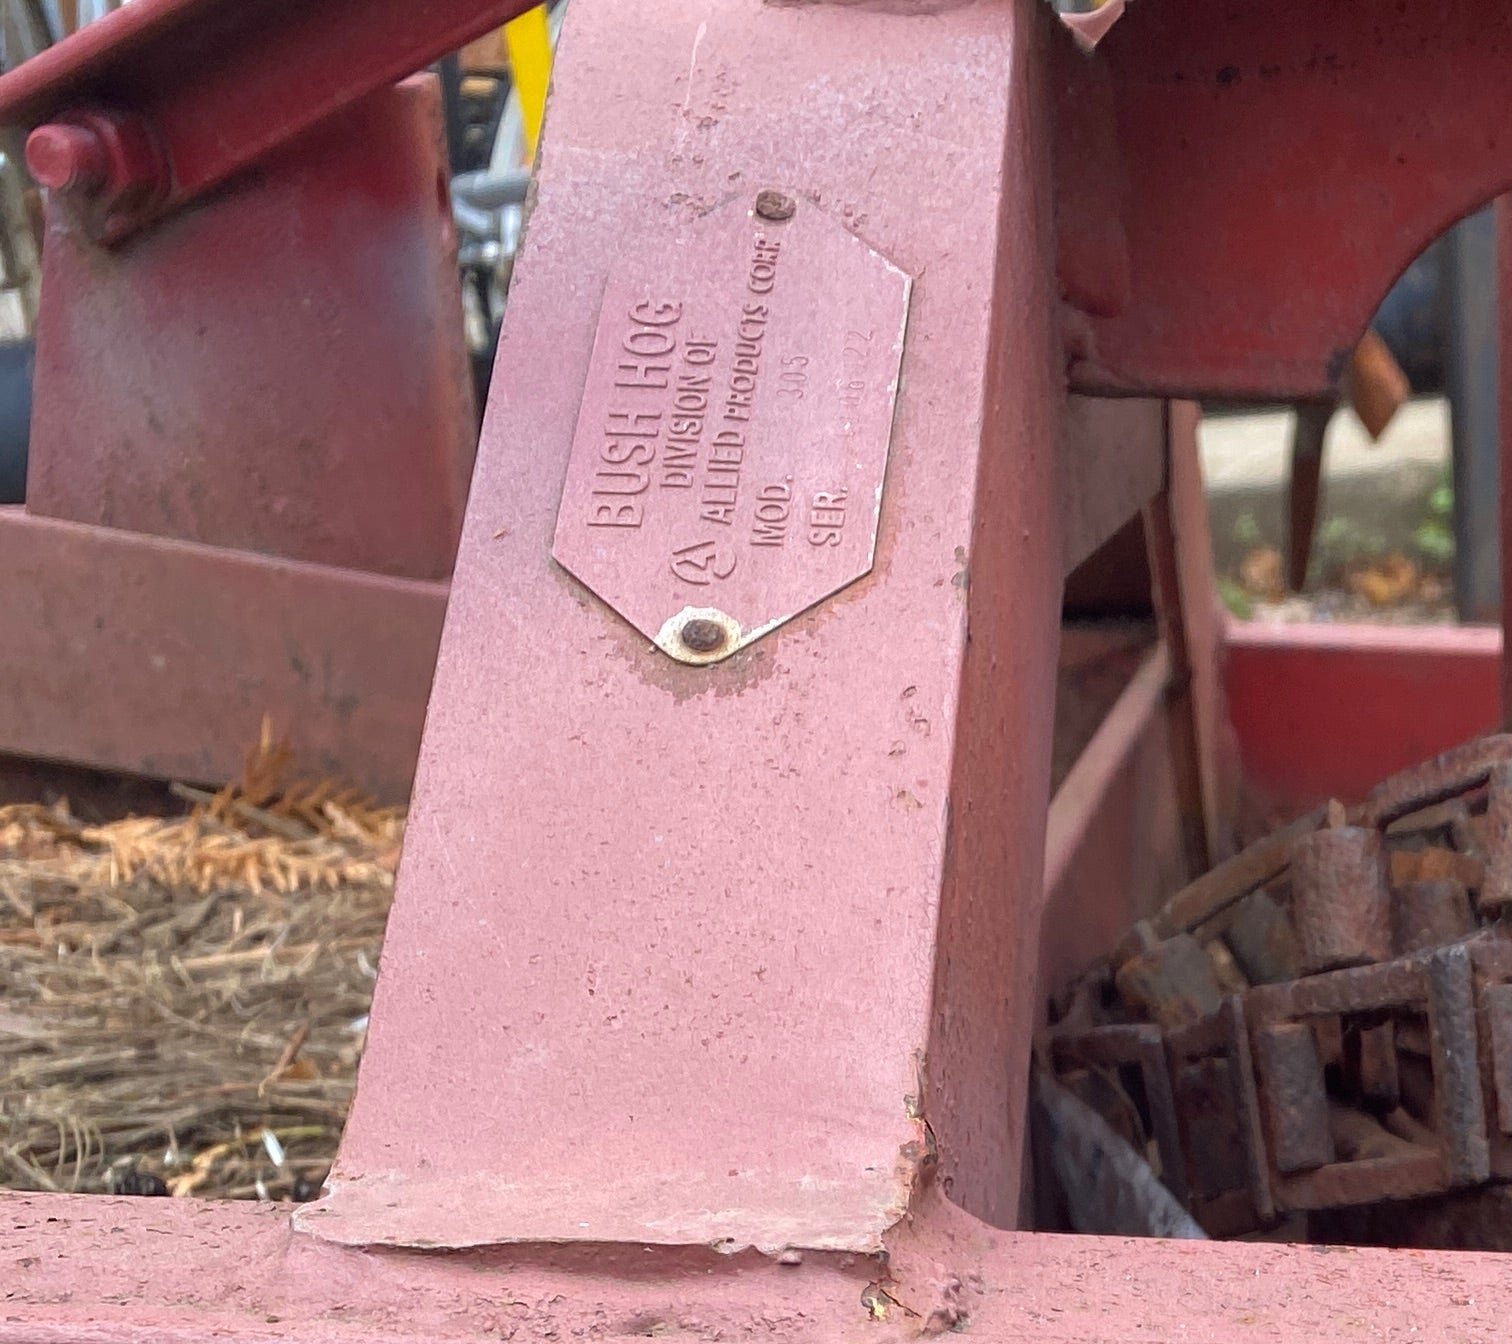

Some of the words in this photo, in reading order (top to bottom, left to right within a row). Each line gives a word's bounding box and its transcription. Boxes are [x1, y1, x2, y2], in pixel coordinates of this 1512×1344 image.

[614, 299, 684, 389] HOG
[685, 335, 718, 368] OF
[586, 411, 662, 529] BUSH
[660, 374, 712, 490] DIVISION
[701, 430, 746, 526] ALLIED
[724, 302, 769, 423] PRODUCTS
[750, 474, 794, 548] MOD.
[776, 355, 809, 399] 305
[807, 486, 849, 547] SER.
